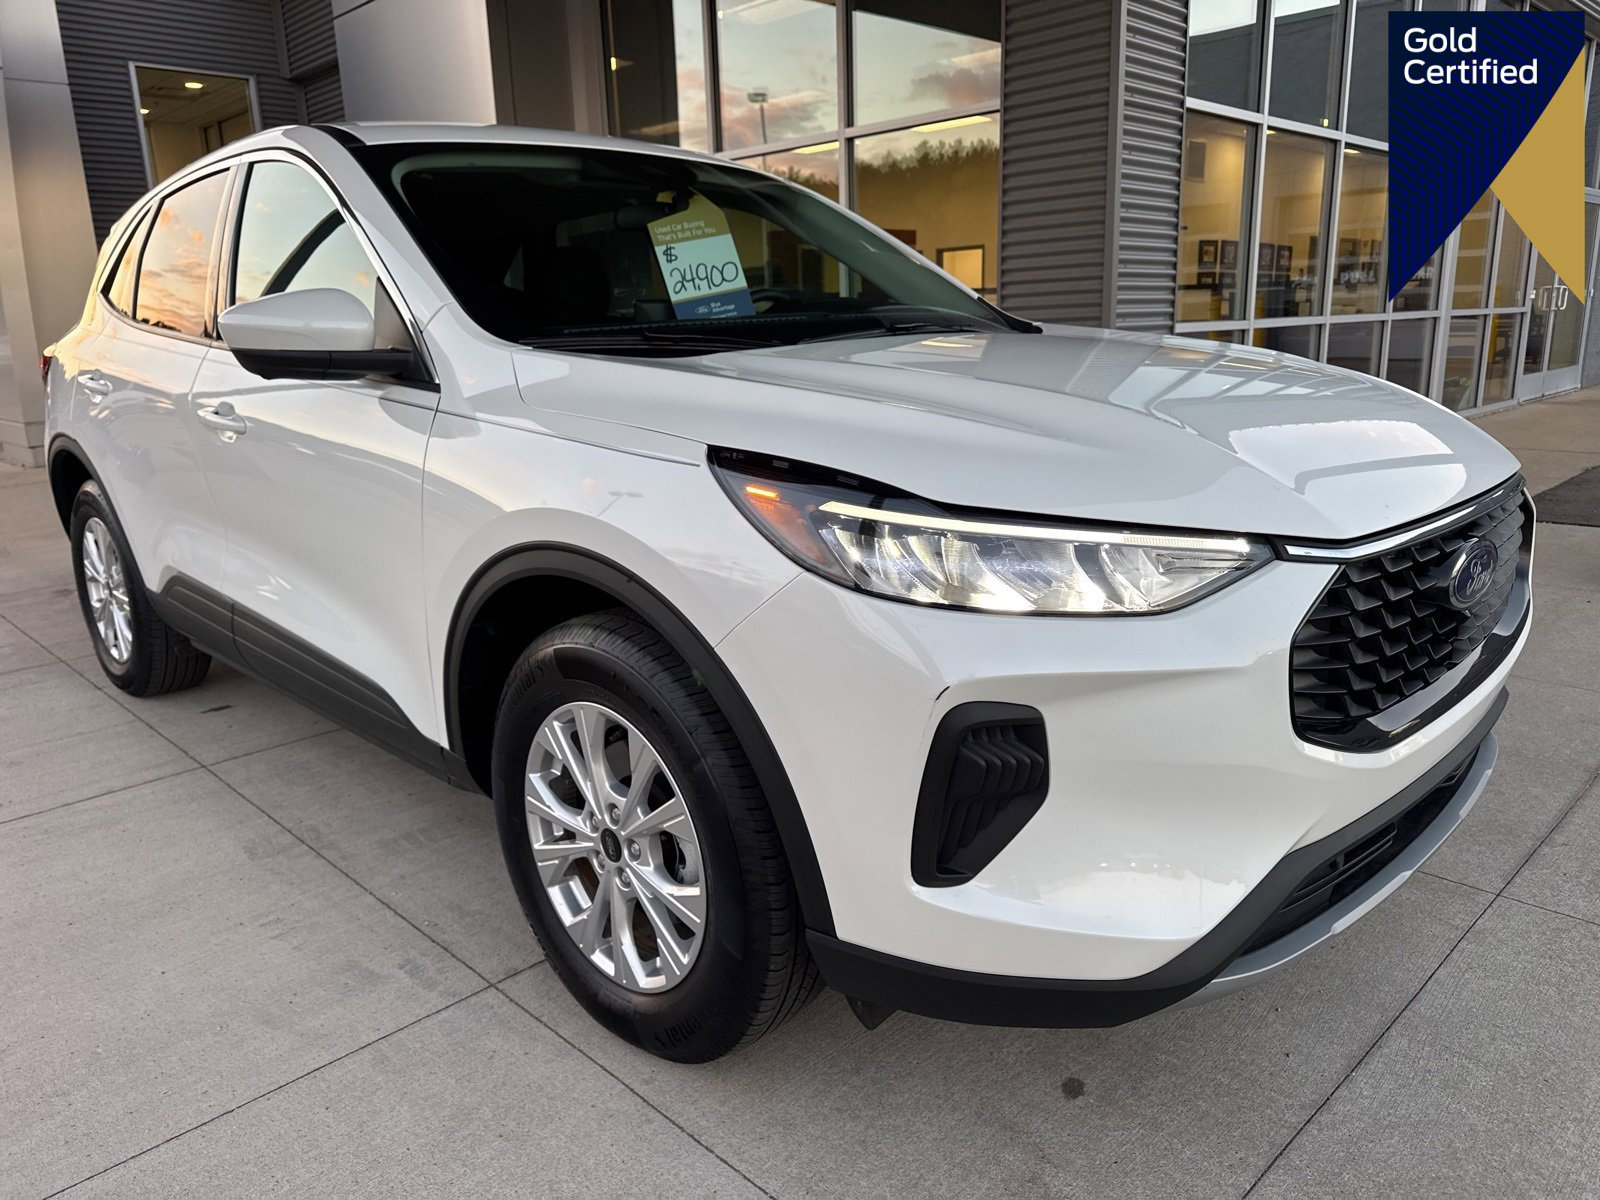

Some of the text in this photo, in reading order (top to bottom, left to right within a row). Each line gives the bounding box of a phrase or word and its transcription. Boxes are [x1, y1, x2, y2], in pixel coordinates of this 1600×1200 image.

[655, 219, 705, 234] Used Car Buying
[657, 232, 677, 241] That's
[677, 229, 692, 239] Built
[692, 228, 703, 237] For
[662, 244, 678, 263] $
[670, 261, 738, 294] 24,900
[1466, 554, 1493, 595] Ford
